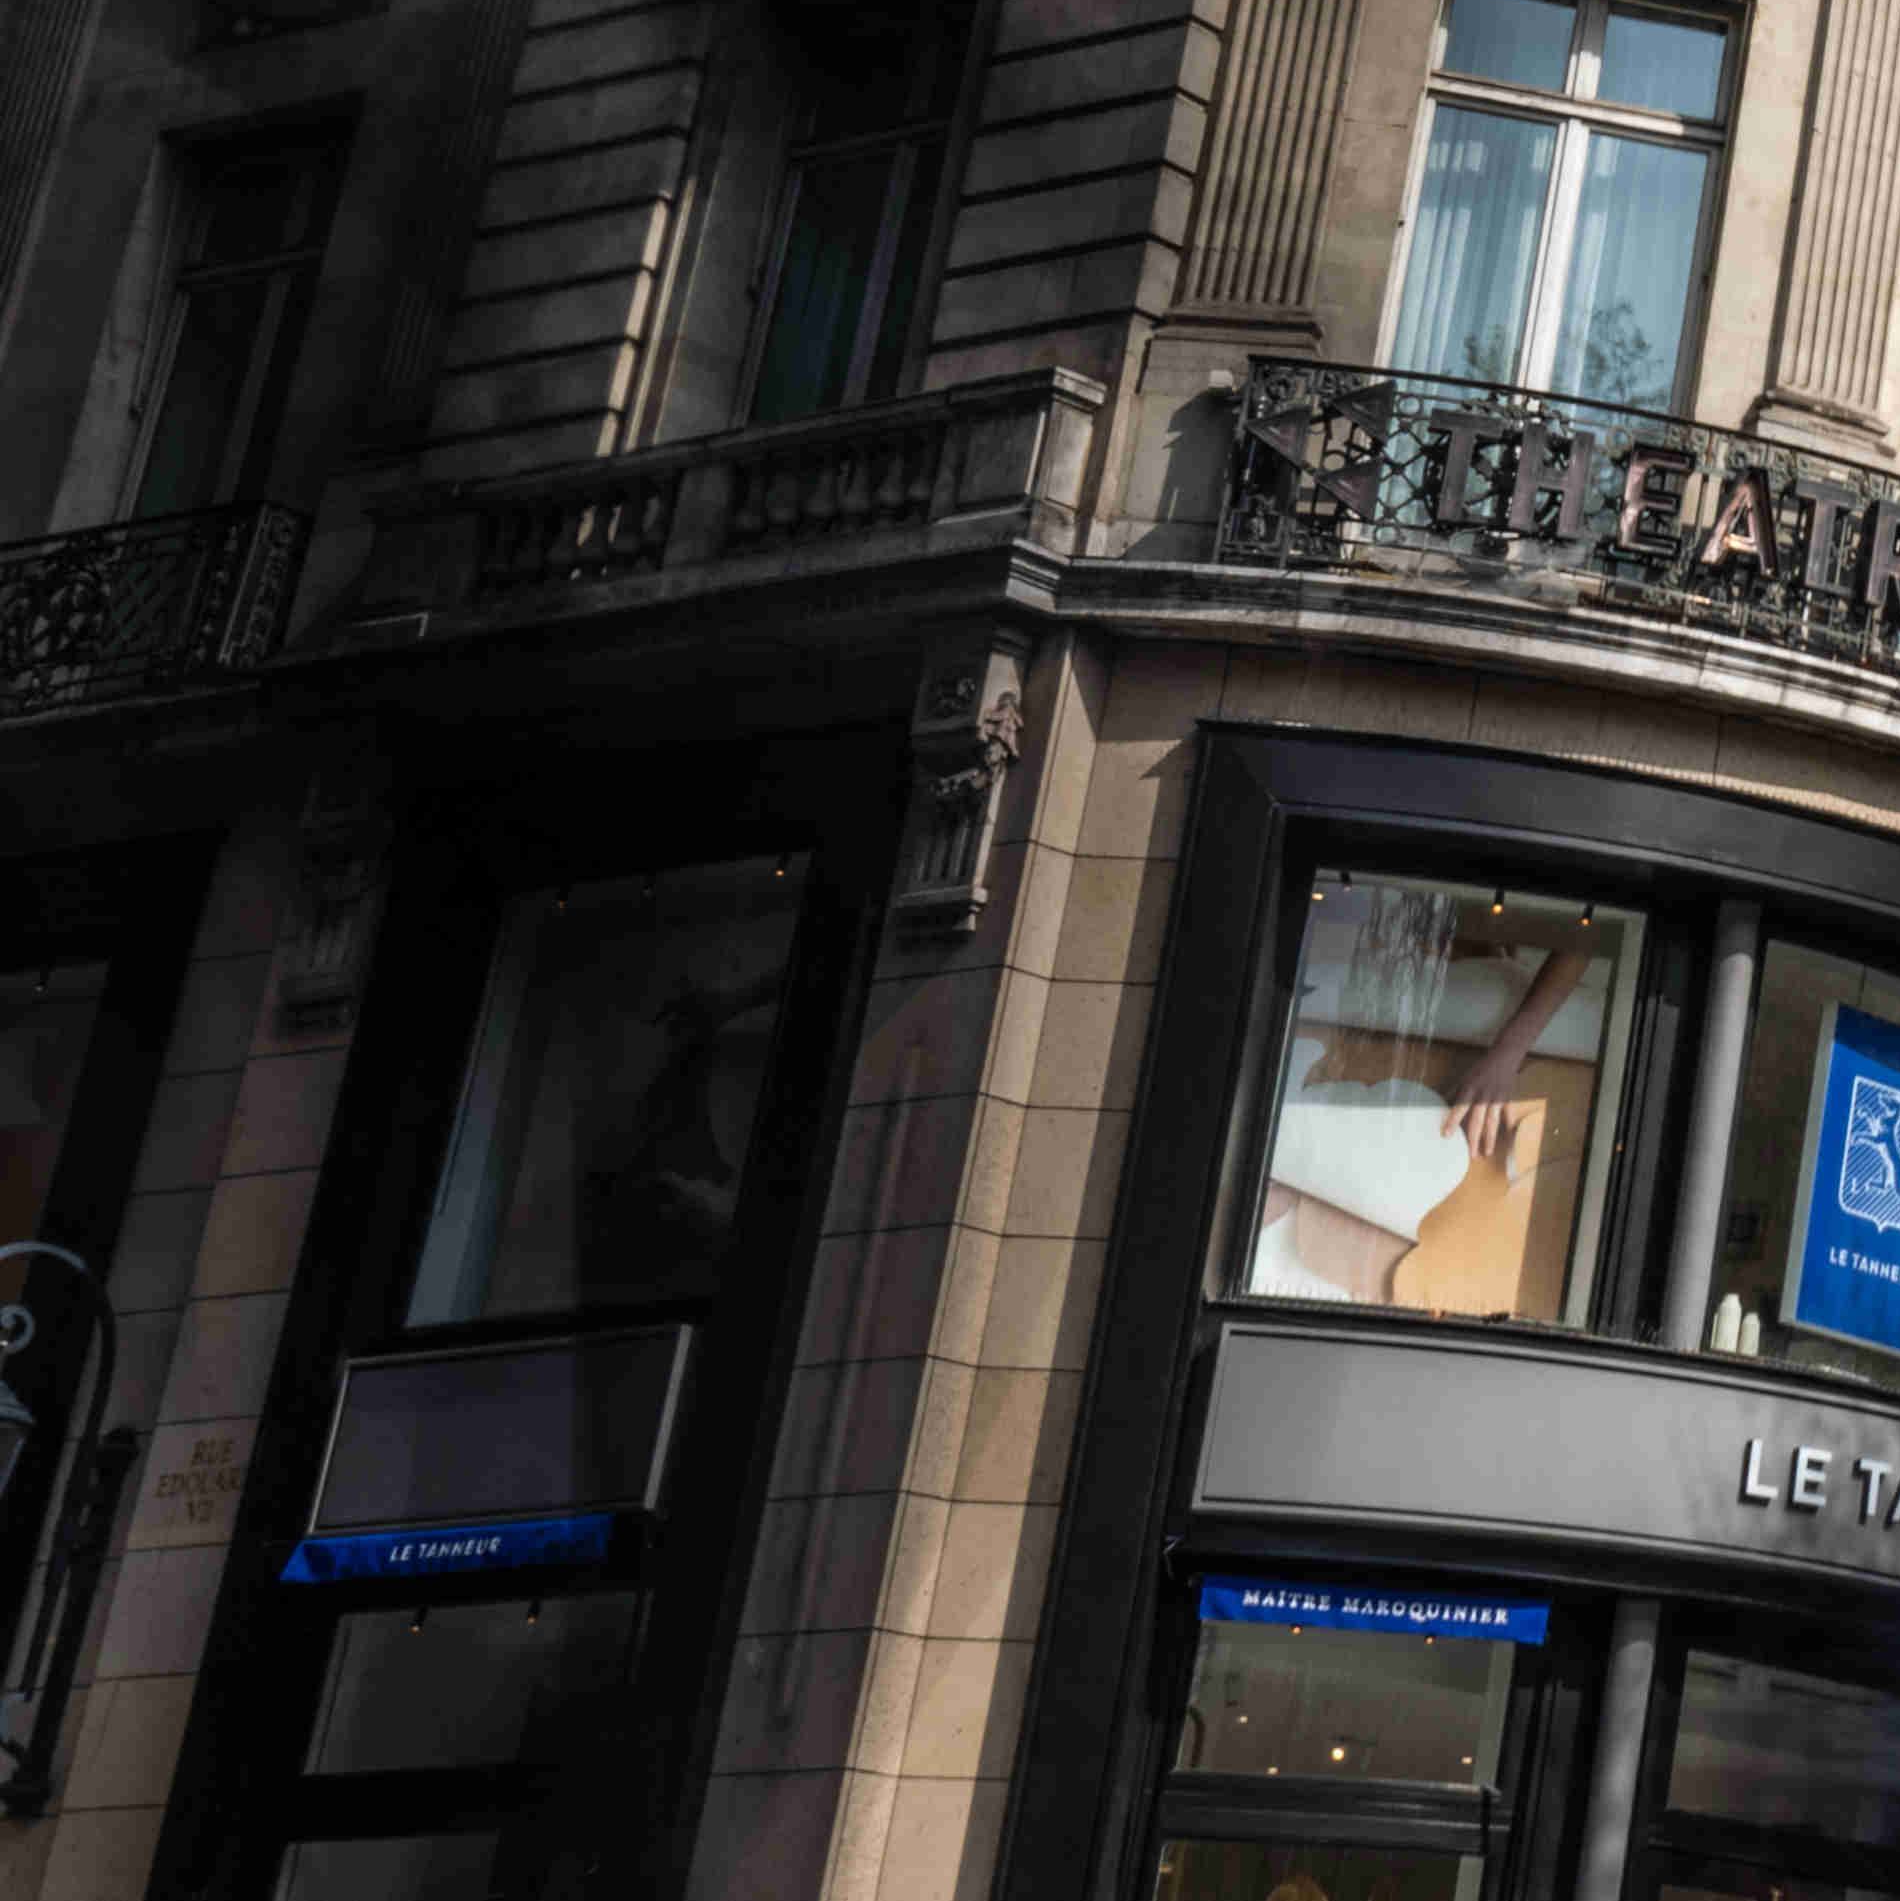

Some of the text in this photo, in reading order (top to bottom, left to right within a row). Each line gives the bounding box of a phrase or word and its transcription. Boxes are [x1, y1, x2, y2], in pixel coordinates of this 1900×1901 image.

[1829, 1246, 1849, 1268] LE
[192, 1436, 233, 1466] RUE
[153, 1469, 241, 1500] EDOUAR
[1740, 1438, 1832, 1511] LE
[389, 1536, 503, 1563] LE TANNEUR
[1341, 1596, 1509, 1625] MAROQUINIER
